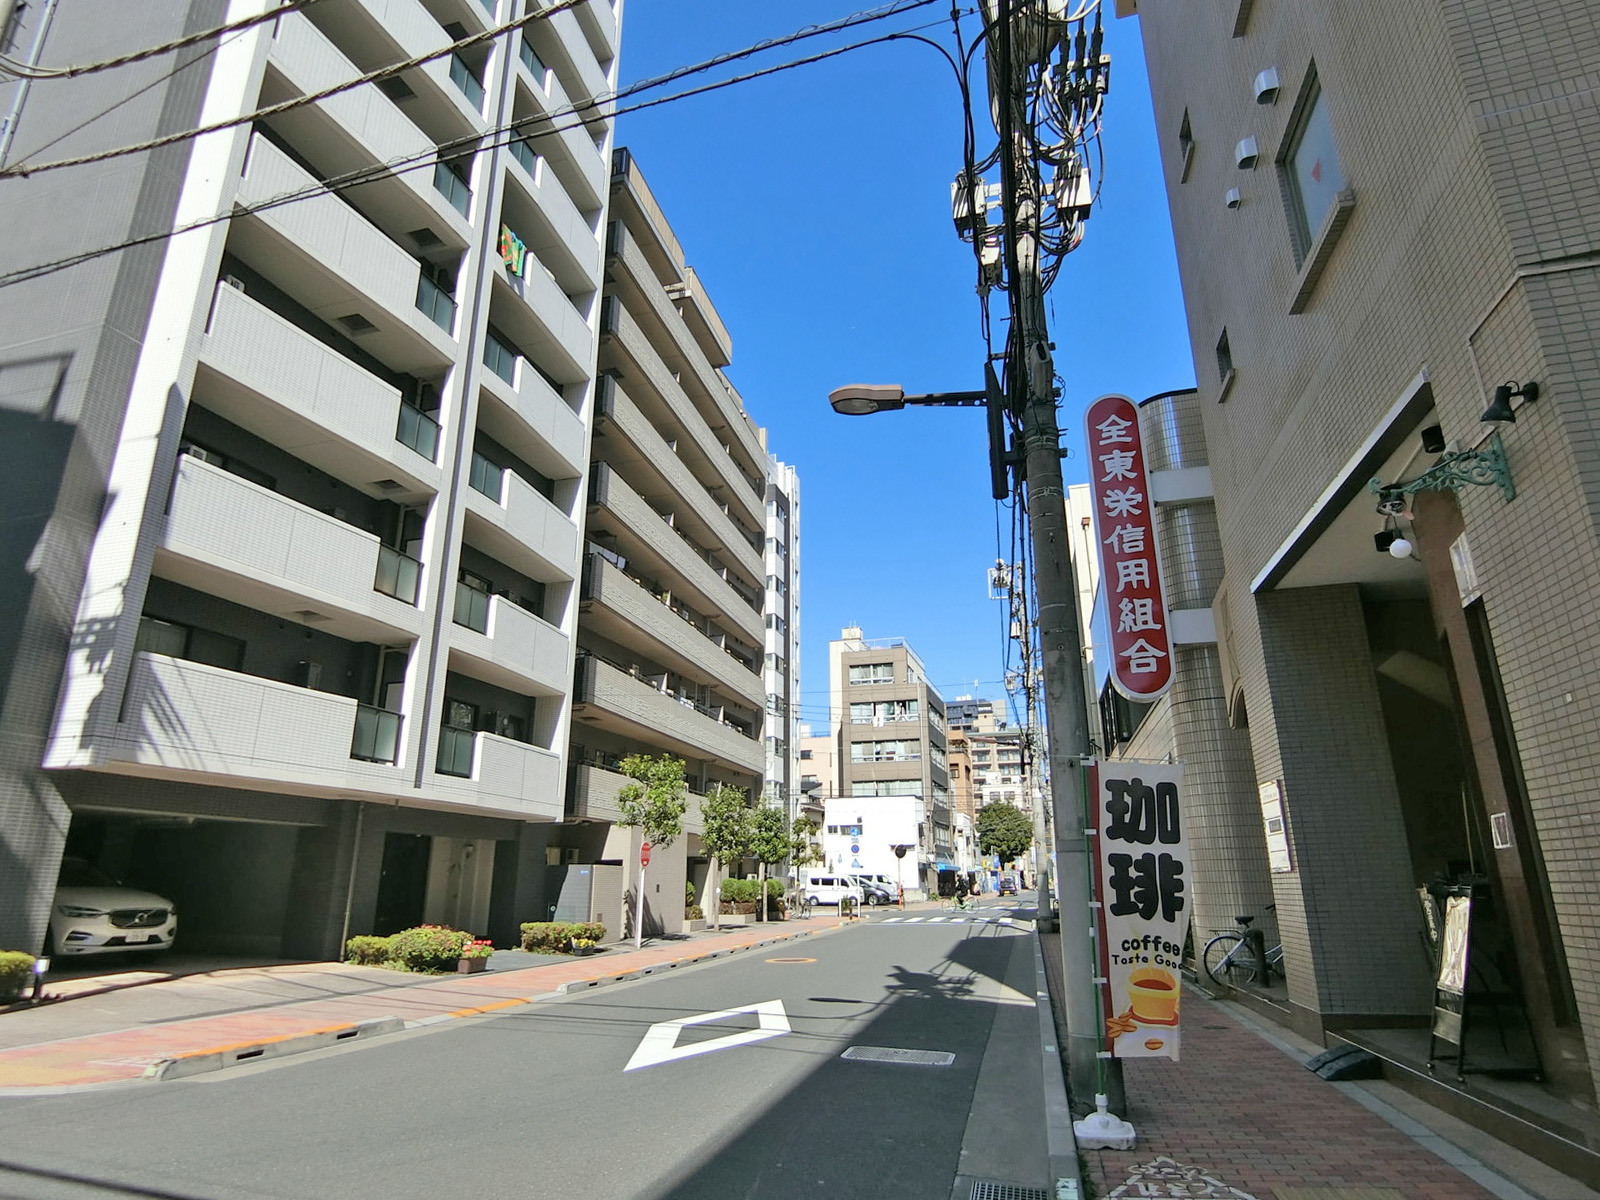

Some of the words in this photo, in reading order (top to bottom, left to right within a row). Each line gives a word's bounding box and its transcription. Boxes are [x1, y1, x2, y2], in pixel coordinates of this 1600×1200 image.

[1095, 413, 1167, 674] 全東栄信用組合
[1105, 778, 1184, 923] 珈琲
[1111, 953, 1149, 965] Taste
[1121, 934, 1181, 957] coffee
